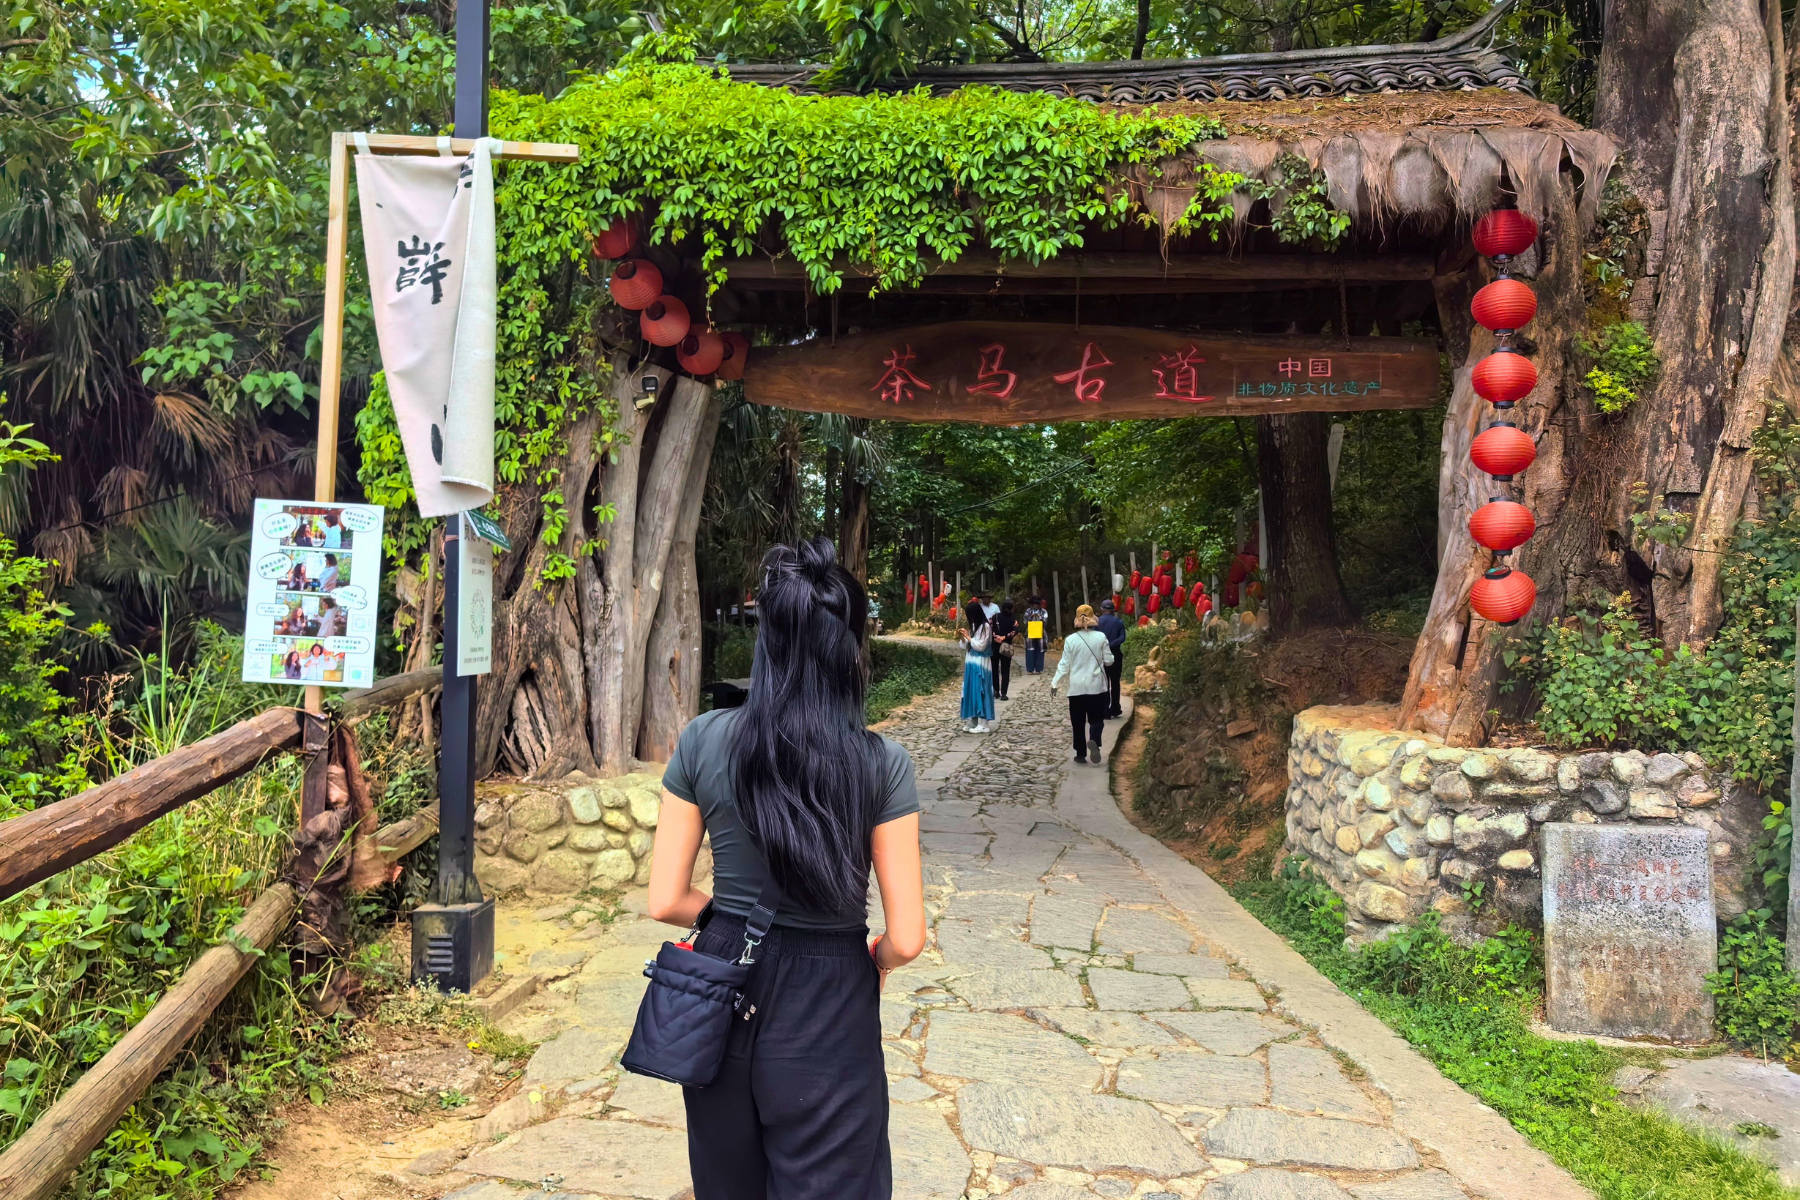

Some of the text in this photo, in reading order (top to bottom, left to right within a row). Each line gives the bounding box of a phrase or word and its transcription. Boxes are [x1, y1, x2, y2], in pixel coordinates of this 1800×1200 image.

[870, 342, 1215, 402] 茶马古道
[1278, 356, 1331, 379] 中国
[1237, 381, 1381, 396] 非物质文化遗产
